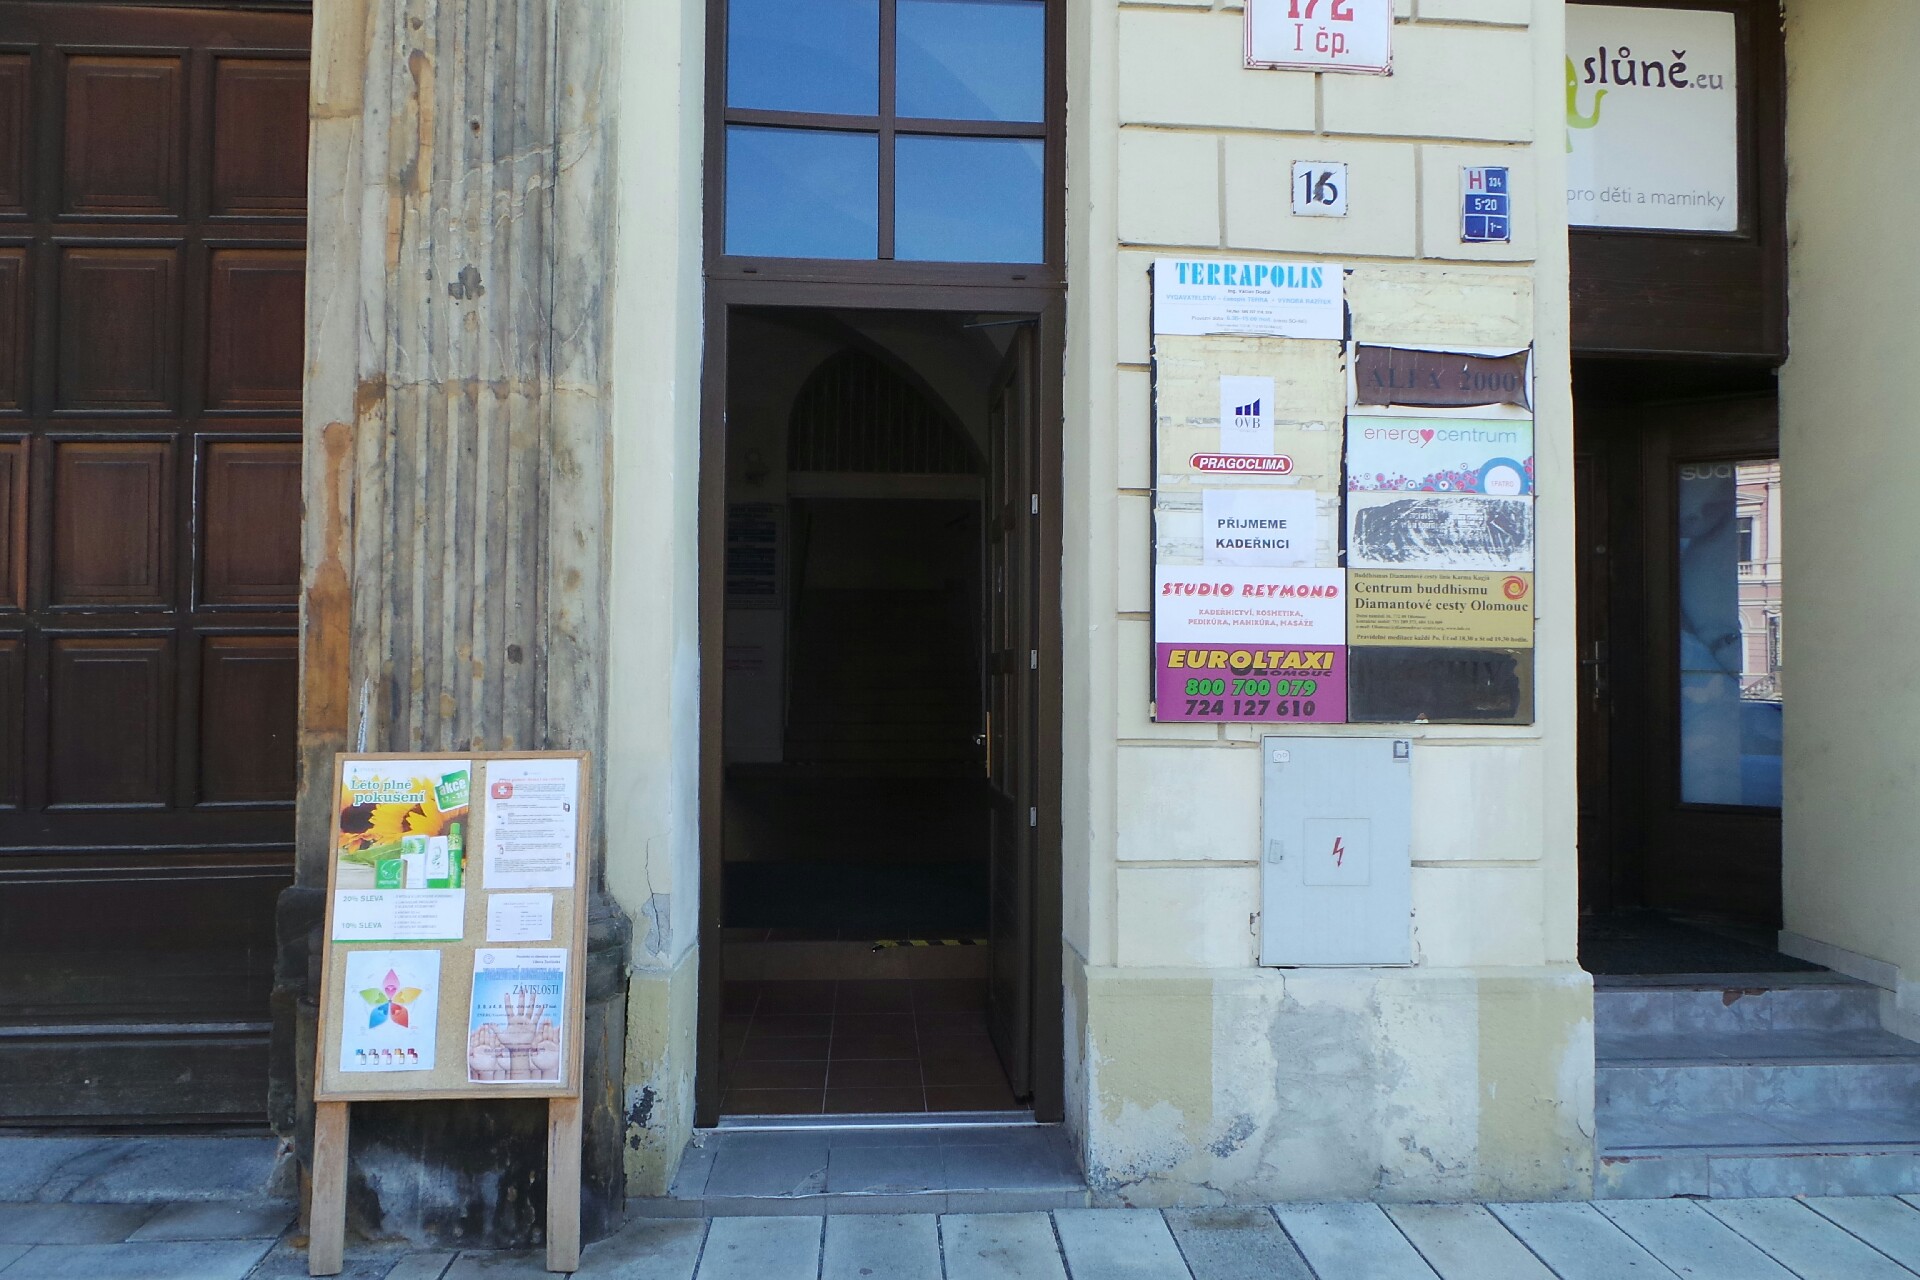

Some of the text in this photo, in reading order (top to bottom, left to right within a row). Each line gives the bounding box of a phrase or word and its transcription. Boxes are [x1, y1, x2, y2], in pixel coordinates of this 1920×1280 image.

[1316, 26, 1349, 58] čp.
[1584, 46, 1723, 89] slůně.eu
[1299, 170, 1338, 205] 16
[1469, 171, 1482, 189] H
[1567, 187, 1725, 211] pro děti a maminky
[1175, 262, 1323, 289] TERRAPOLIS
[1235, 417, 1260, 429] OVB
[1437, 428, 1517, 444] centrum
[1199, 458, 1286, 470] PRAGOCLIMA
[1217, 517, 1287, 529] PŘIJMEME
[1216, 537, 1289, 549] KADEŘNICI
[1162, 582, 1339, 598] STUDIO REYMOND
[1354, 582, 1488, 596] Centrum buddhismu
[1355, 597, 1528, 613] Diamantové cesty Olomouc
[1167, 650, 1335, 670] EUROLTAXI
[1185, 678, 1317, 697] 800 700 079
[1185, 700, 1316, 717] 724 127 610
[439, 779, 467, 796] akce
[355, 791, 425, 806] pokušení
